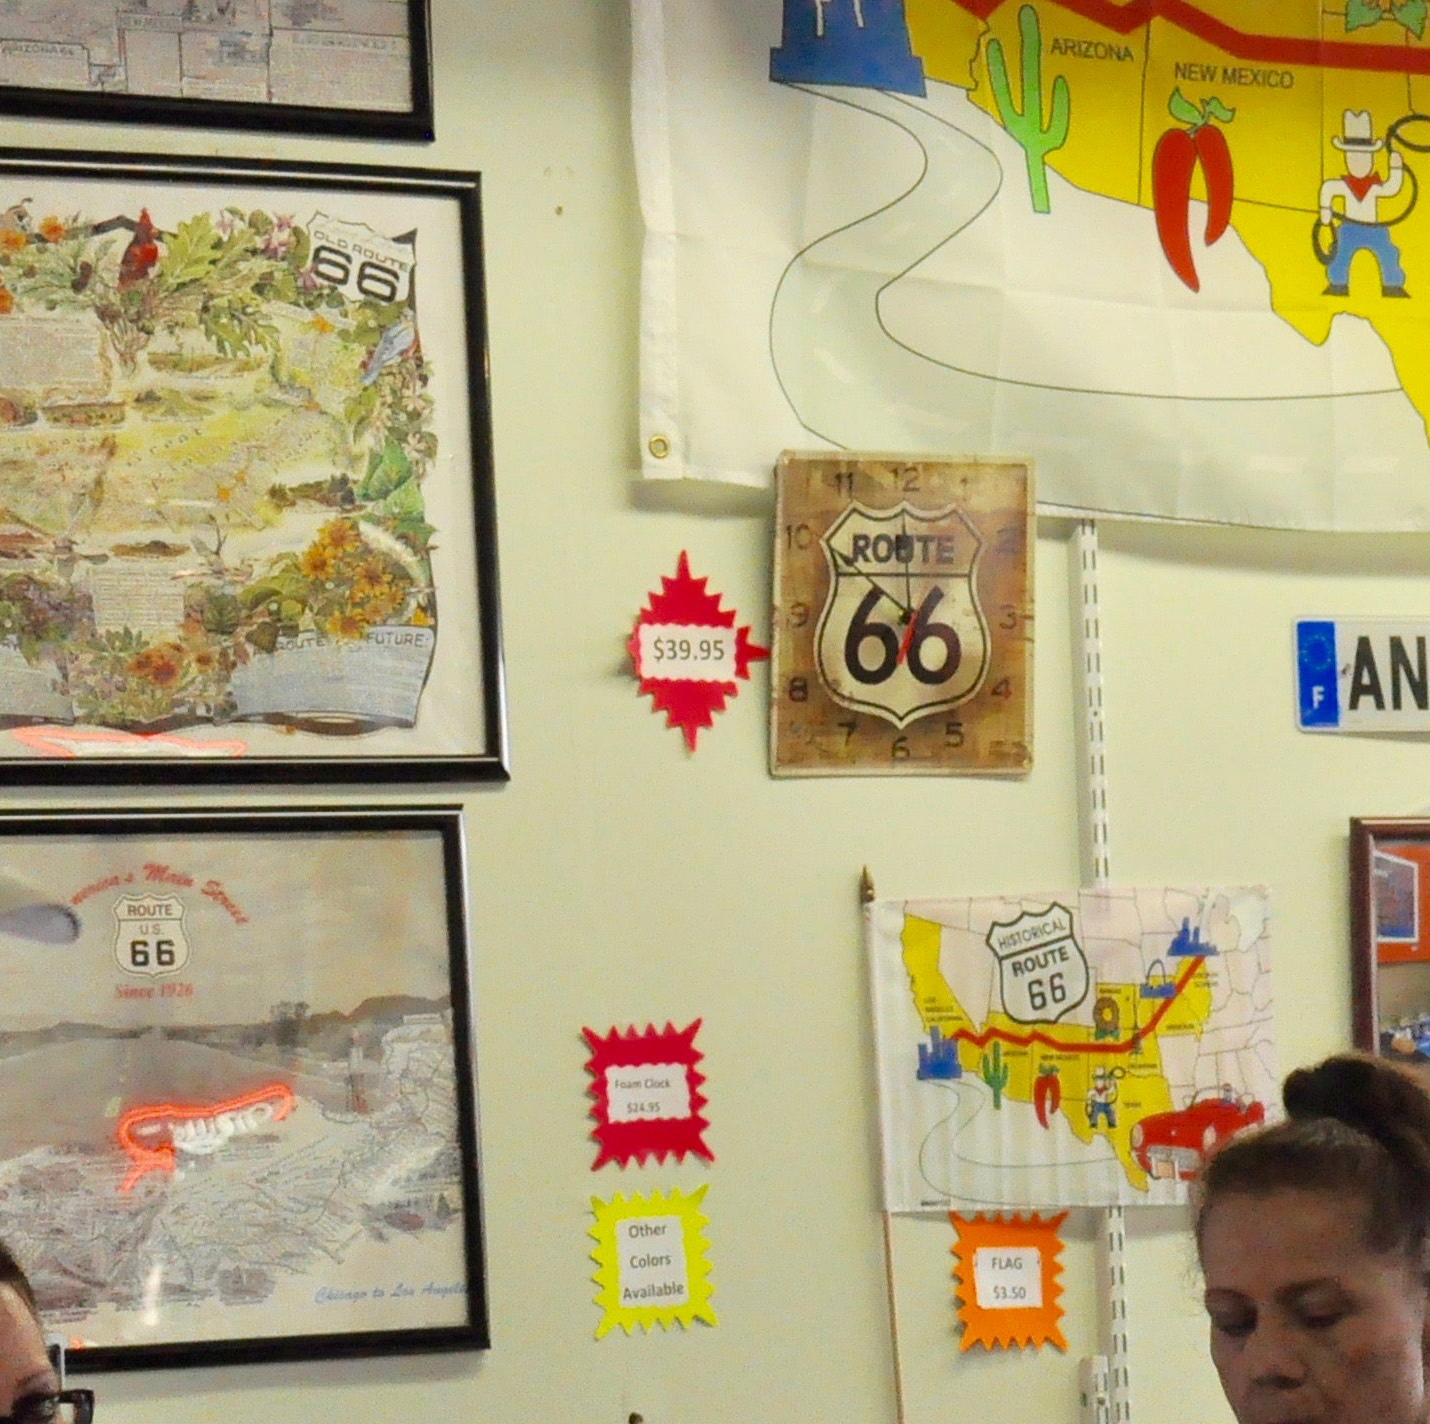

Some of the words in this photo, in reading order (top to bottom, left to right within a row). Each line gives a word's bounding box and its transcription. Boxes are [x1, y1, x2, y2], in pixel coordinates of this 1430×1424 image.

[1050, 37, 1134, 62] ARIZONA
[1174, 62, 1217, 83] NEW
[1222, 67, 1294, 89] MEXICO
[313, 229, 348, 250] OLD
[352, 243, 409, 273] ROUTE
[312, 245, 399, 303] 66
[892, 466, 920, 493] 12
[785, 523, 812, 550] 10
[851, 533, 954, 564] ROUTE
[844, 584, 961, 685] 66
[653, 637, 725, 662] $39.95
[1312, 686, 1324, 710] F
[945, 722, 965, 748] 5
[71, 873, 134, 906] merica's
[127, 904, 173, 917] ROUTE
[997, 918, 1068, 950] HISTORICAL
[130, 940, 176, 968] 66
[1011, 946, 1069, 978] ROUTE
[1027, 972, 1067, 1012] 66
[614, 1079, 642, 1089] Foam
[644, 1078, 671, 1089] Clock
[627, 1102, 661, 1114] $24.95
[629, 1224, 667, 1238] Other
[630, 1253, 672, 1269] Colors
[992, 1257, 1023, 1270] FLAG
[623, 1281, 684, 1299] Available
[993, 1285, 1026, 1300] $3.50
